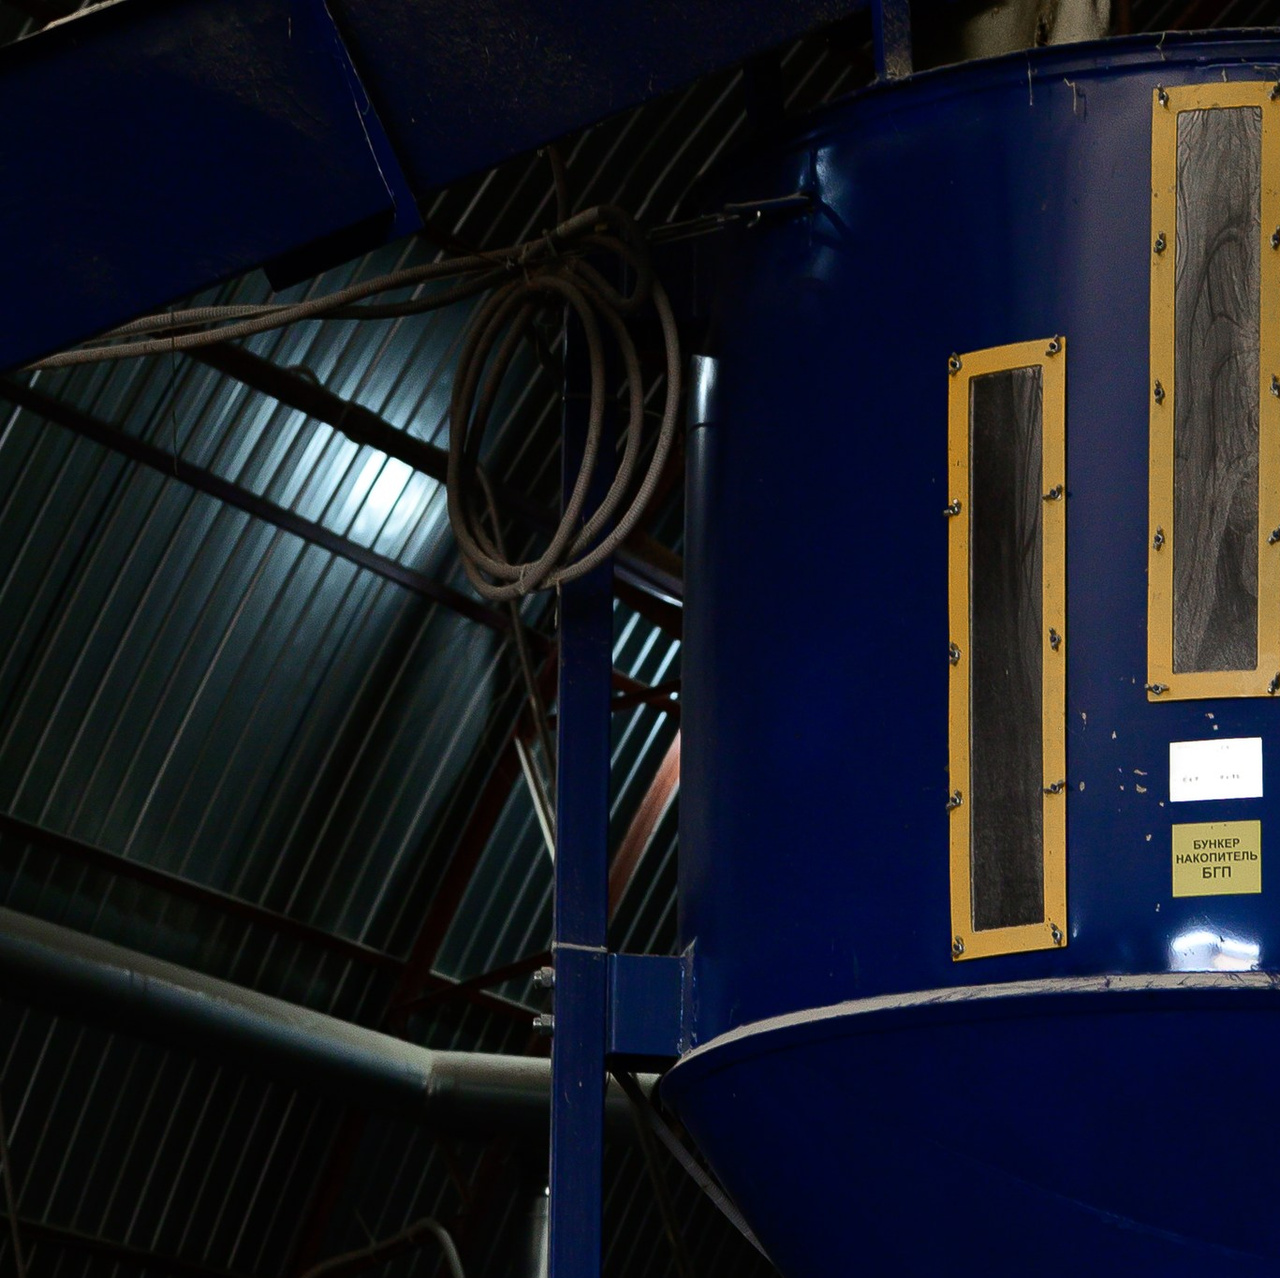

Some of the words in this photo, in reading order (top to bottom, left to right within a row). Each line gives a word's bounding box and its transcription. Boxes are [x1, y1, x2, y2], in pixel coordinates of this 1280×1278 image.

[1193, 838, 1240, 850] БУНКЕР
[1176, 850, 1258, 864] НАКОПИТЕЛЬ
[1202, 866, 1232, 879] БГП
